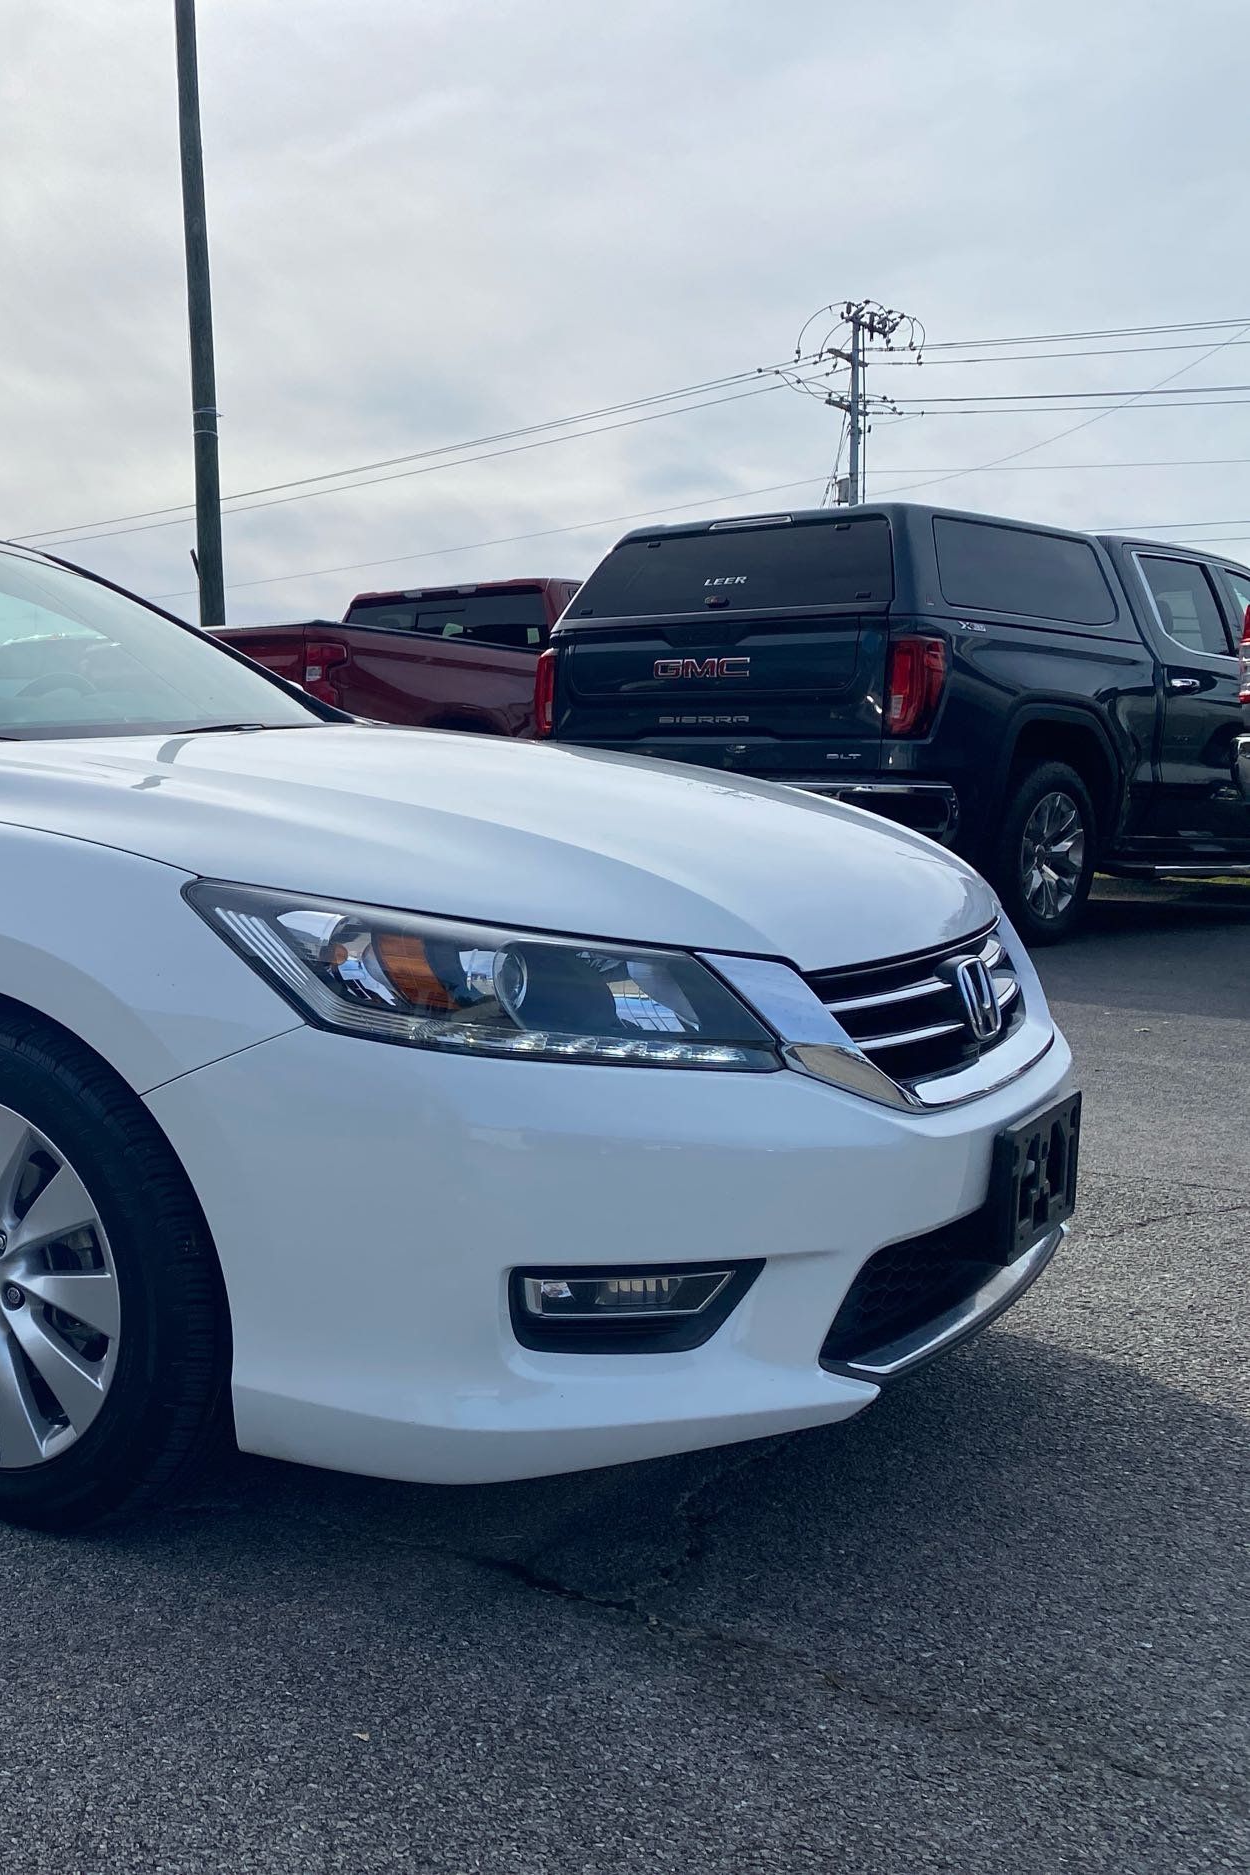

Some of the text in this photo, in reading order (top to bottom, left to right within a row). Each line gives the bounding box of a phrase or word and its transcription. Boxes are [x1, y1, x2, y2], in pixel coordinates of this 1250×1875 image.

[704, 576, 747, 586] LEER
[653, 657, 750, 680] GMC
[659, 715, 750, 724] SIERRA
